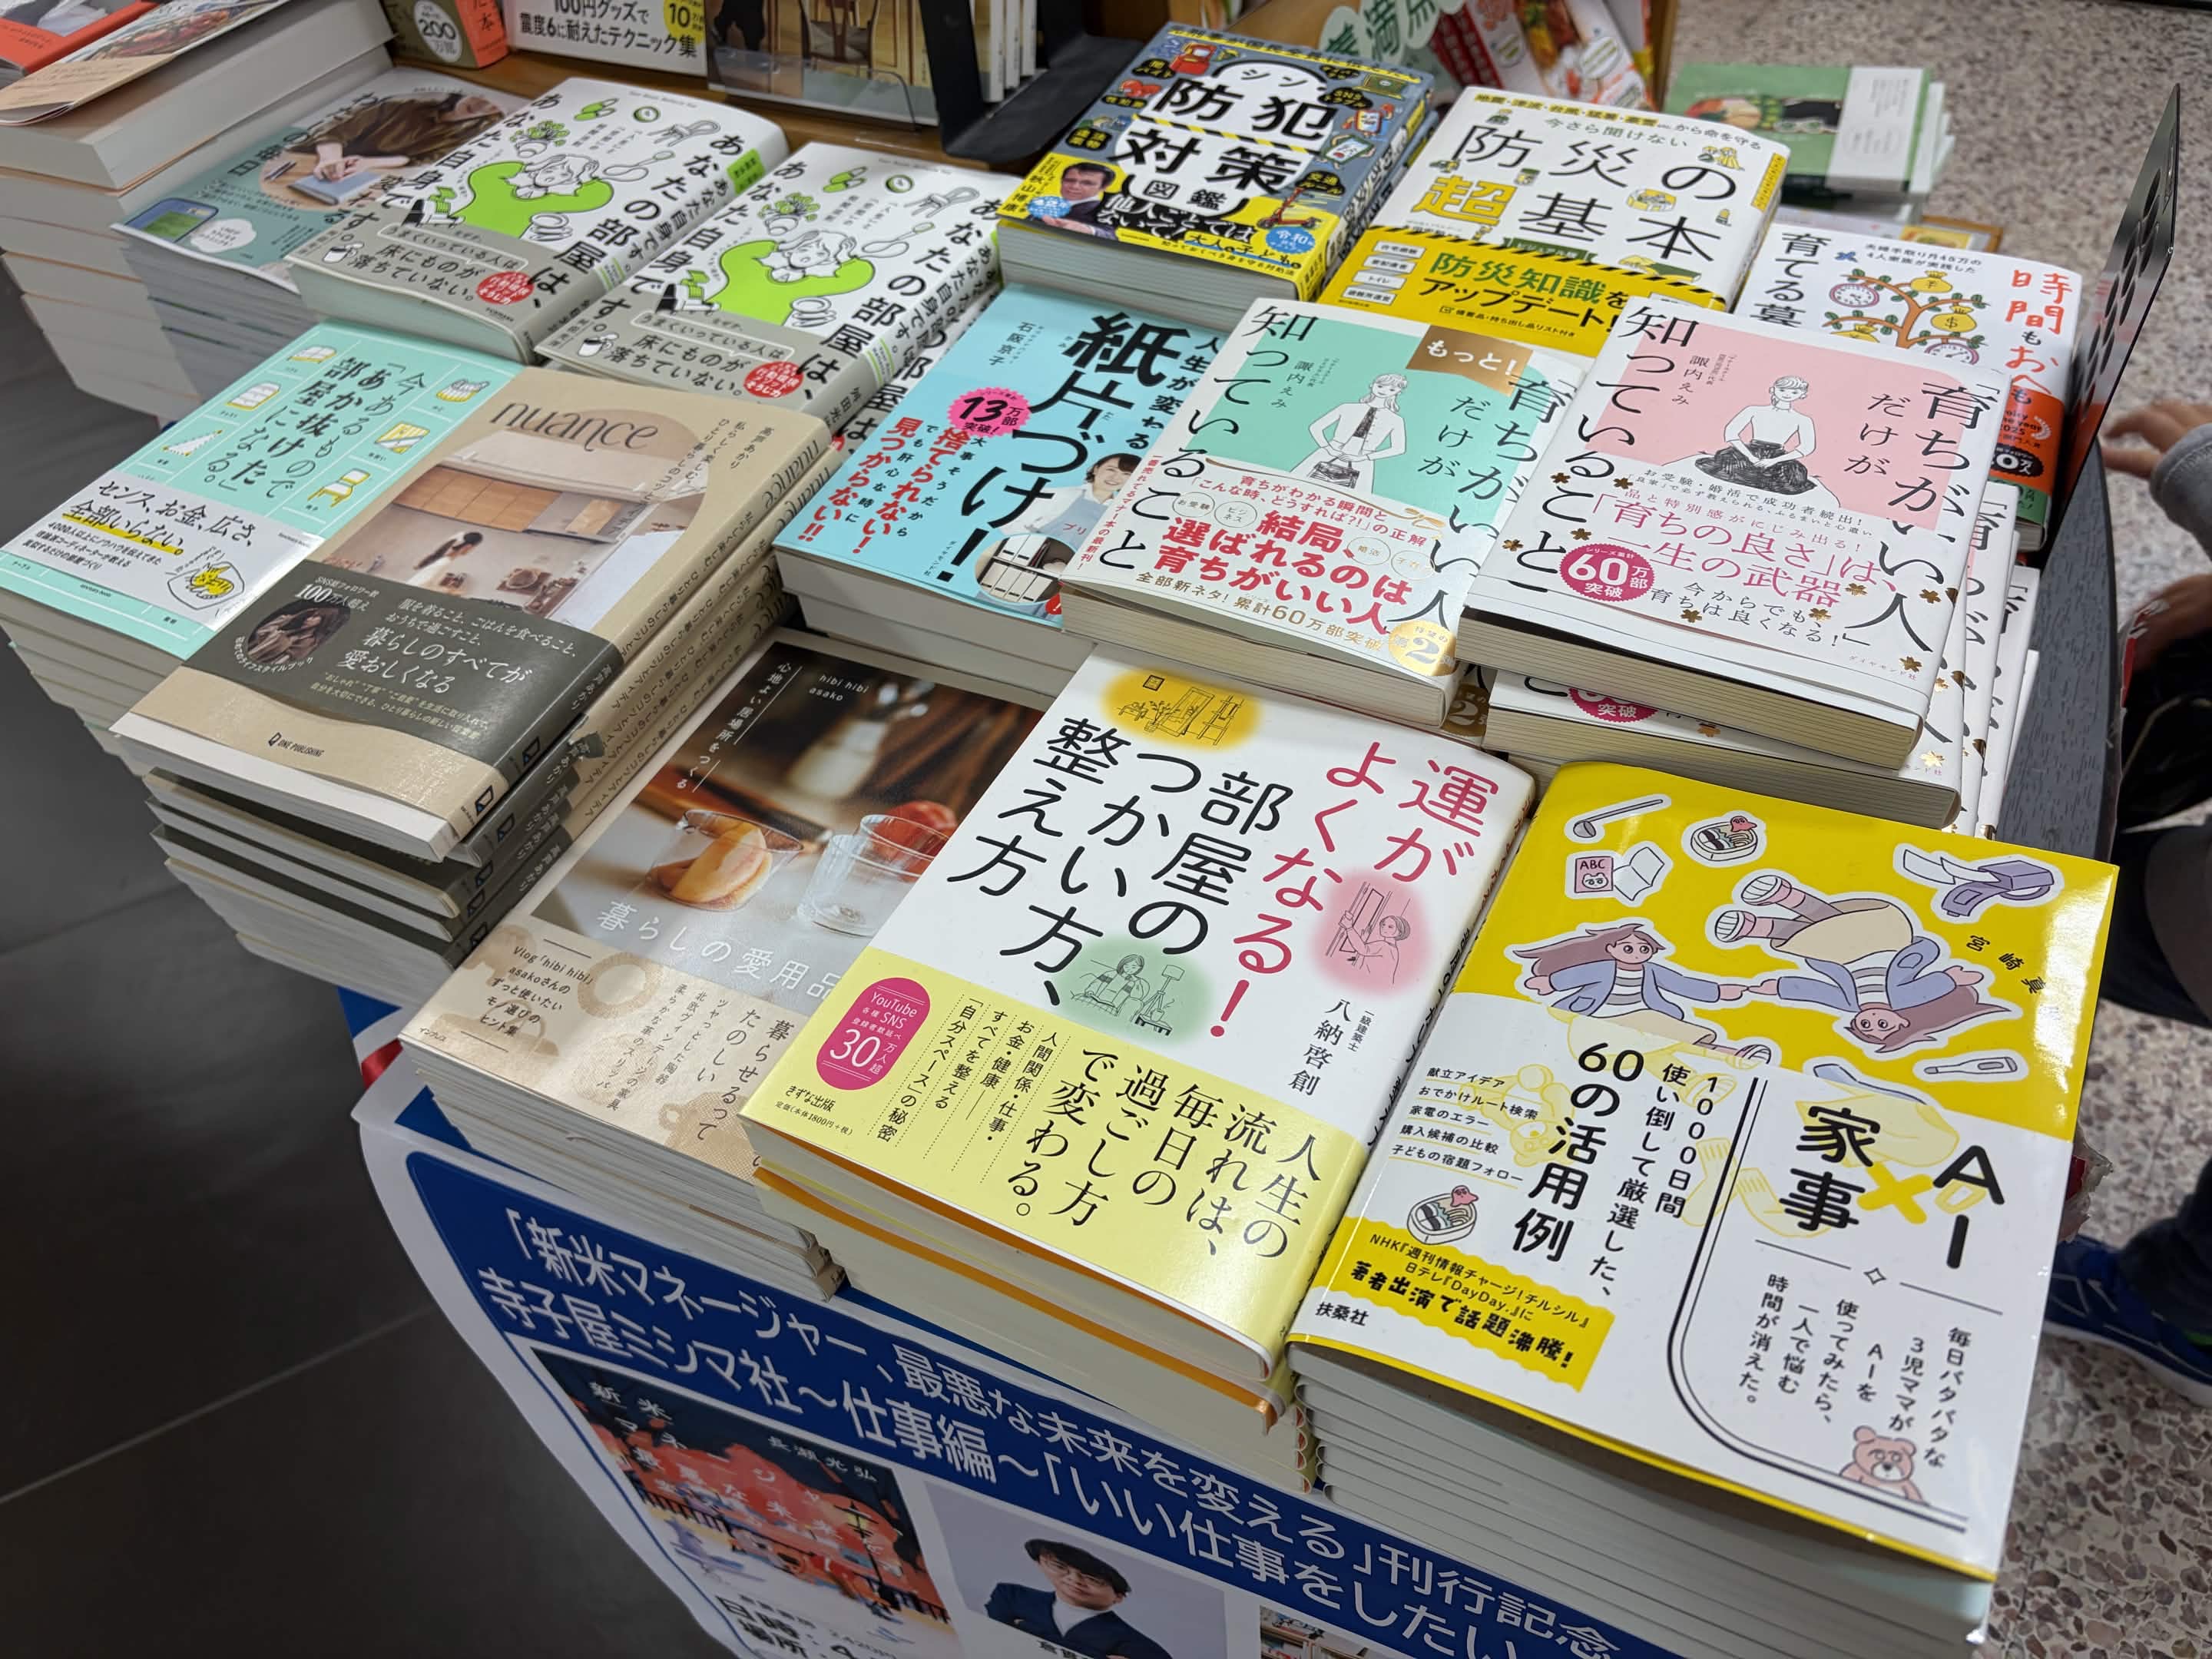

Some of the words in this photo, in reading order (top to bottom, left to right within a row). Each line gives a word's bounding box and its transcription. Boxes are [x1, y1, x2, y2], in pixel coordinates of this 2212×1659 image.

[519, 12, 699, 58] 震度6に耐えたテクニック集
[1152, 77, 1339, 141] 防犯
[1240, 68, 1307, 89] シン
[339, 91, 563, 243] あなた自身です。
[1107, 127, 1303, 196] 対策
[1452, 125, 1738, 201] 防災の
[1544, 117, 1689, 147] 今さら聞けない
[528, 134, 744, 310] あなたの部屋は、
[1142, 180, 1228, 212] 図鑑
[376, 243, 486, 278] 床にものが
[593, 158, 808, 333] あなた自身です。
[1427, 252, 1629, 310] 防災知識を
[797, 197, 1003, 402] あなたの部屋は、
[1419, 277, 1620, 333] アップデート！
[633, 334, 752, 374] 床にものが
[1426, 338, 1518, 376] もっと！
[488, 401, 658, 452] nuance
[959, 396, 1008, 422] 13
[1001, 406, 1025, 426] 万部
[1124, 336, 1220, 450] 人生が変わる
[937, 312, 1190, 583] 紙片づけ！
[1098, 305, 1318, 570] 知っていること
[1417, 394, 1492, 478] だけが
[1515, 304, 1701, 578] 知っていること
[1846, 391, 1912, 478] だけが
[852, 426, 971, 555] 捨てられない！
[1240, 475, 1387, 522] 育ちがわかる瞬間と
[1161, 516, 1413, 606] 選ばれるのは
[1255, 509, 1356, 559] 結局、
[1568, 552, 1629, 587] 60
[1591, 493, 1898, 592] 「育ちの良さ」は、
[1153, 544, 1389, 636] 育ちがいい人
[1584, 582, 1624, 600] 突破
[1606, 535, 1842, 609] 一生の武器
[1628, 565, 1651, 591] 万部
[1683, 581, 1823, 629] 今からでも、
[1650, 588, 1839, 647] 育ちは良くなる！
[336, 648, 456, 694] 愛おしくなる
[362, 625, 534, 684] 暮らしのすべてが
[819, 673, 843, 687] hibi
[845, 680, 870, 694] hibi
[809, 686, 844, 702] asako
[1597, 703, 1637, 719] 突破
[946, 716, 1131, 898] 整え方
[1373, 757, 1500, 884] 運が
[999, 750, 1203, 1008] つかい方、
[1127, 769, 1294, 956] 部屋の
[1207, 741, 1397, 1038] よくなる！
[1578, 858, 1608, 872] ABC
[507, 965, 571, 995] asakoさんの
[596, 900, 839, 1000] 暮らしの愛用品
[478, 1013, 519, 1038] ヒント集
[485, 995, 542, 1025] モノ選びの
[491, 977, 564, 1012] ずっと使いたい
[870, 991, 919, 1018] YouTube
[879, 1011, 908, 1031] SNS
[697, 1008, 762, 1084] たのしい
[829, 1028, 881, 1069] 30
[876, 997, 985, 1144] 「自分スペース」の秘密
[934, 1009, 1008, 1111] すべてを整える
[1286, 997, 1353, 1098] 八納啓創
[1426, 1066, 1506, 1089] 献立アイデア
[783, 1084, 837, 1114] きずな出版
[1007, 1049, 1119, 1218] で変わる。
[1408, 1104, 1491, 1128] 家電のエラー
[1418, 1085, 1540, 1121] おでかけルート検索
[1047, 1062, 1165, 1227] 過ごし方
[1132, 1083, 1220, 1207] 毎日の
[1392, 1144, 1525, 1184] 子どもの宿題フォロー
[1399, 1123, 1501, 1156] 購入候補の比較
[1512, 1040, 1646, 1265] 60の活用例
[1653, 1075, 1721, 1220] 1000日間
[1779, 1104, 1881, 1232] 家事
[1185, 1102, 1277, 1257] 流れは、
[1243, 1132, 1324, 1260] 人生の
[1588, 1061, 1694, 1298] 使い倒して厳選した、
[1932, 1144, 2006, 1270] AI
[1314, 1300, 1371, 1329] 扶桑社
[1349, 1259, 1576, 1369] 著者出演で話題沸騰！
[1738, 1273, 1790, 1405] 時間が消えた。
[1777, 1303, 1820, 1396] 一人で悩む
[1813, 1297, 1861, 1424] 使ってみたら、
[1856, 1343, 1885, 1402] AIを
[1887, 1336, 1926, 1432] 3児ママが
[1923, 1325, 1973, 1470] 毎日バタバタな
